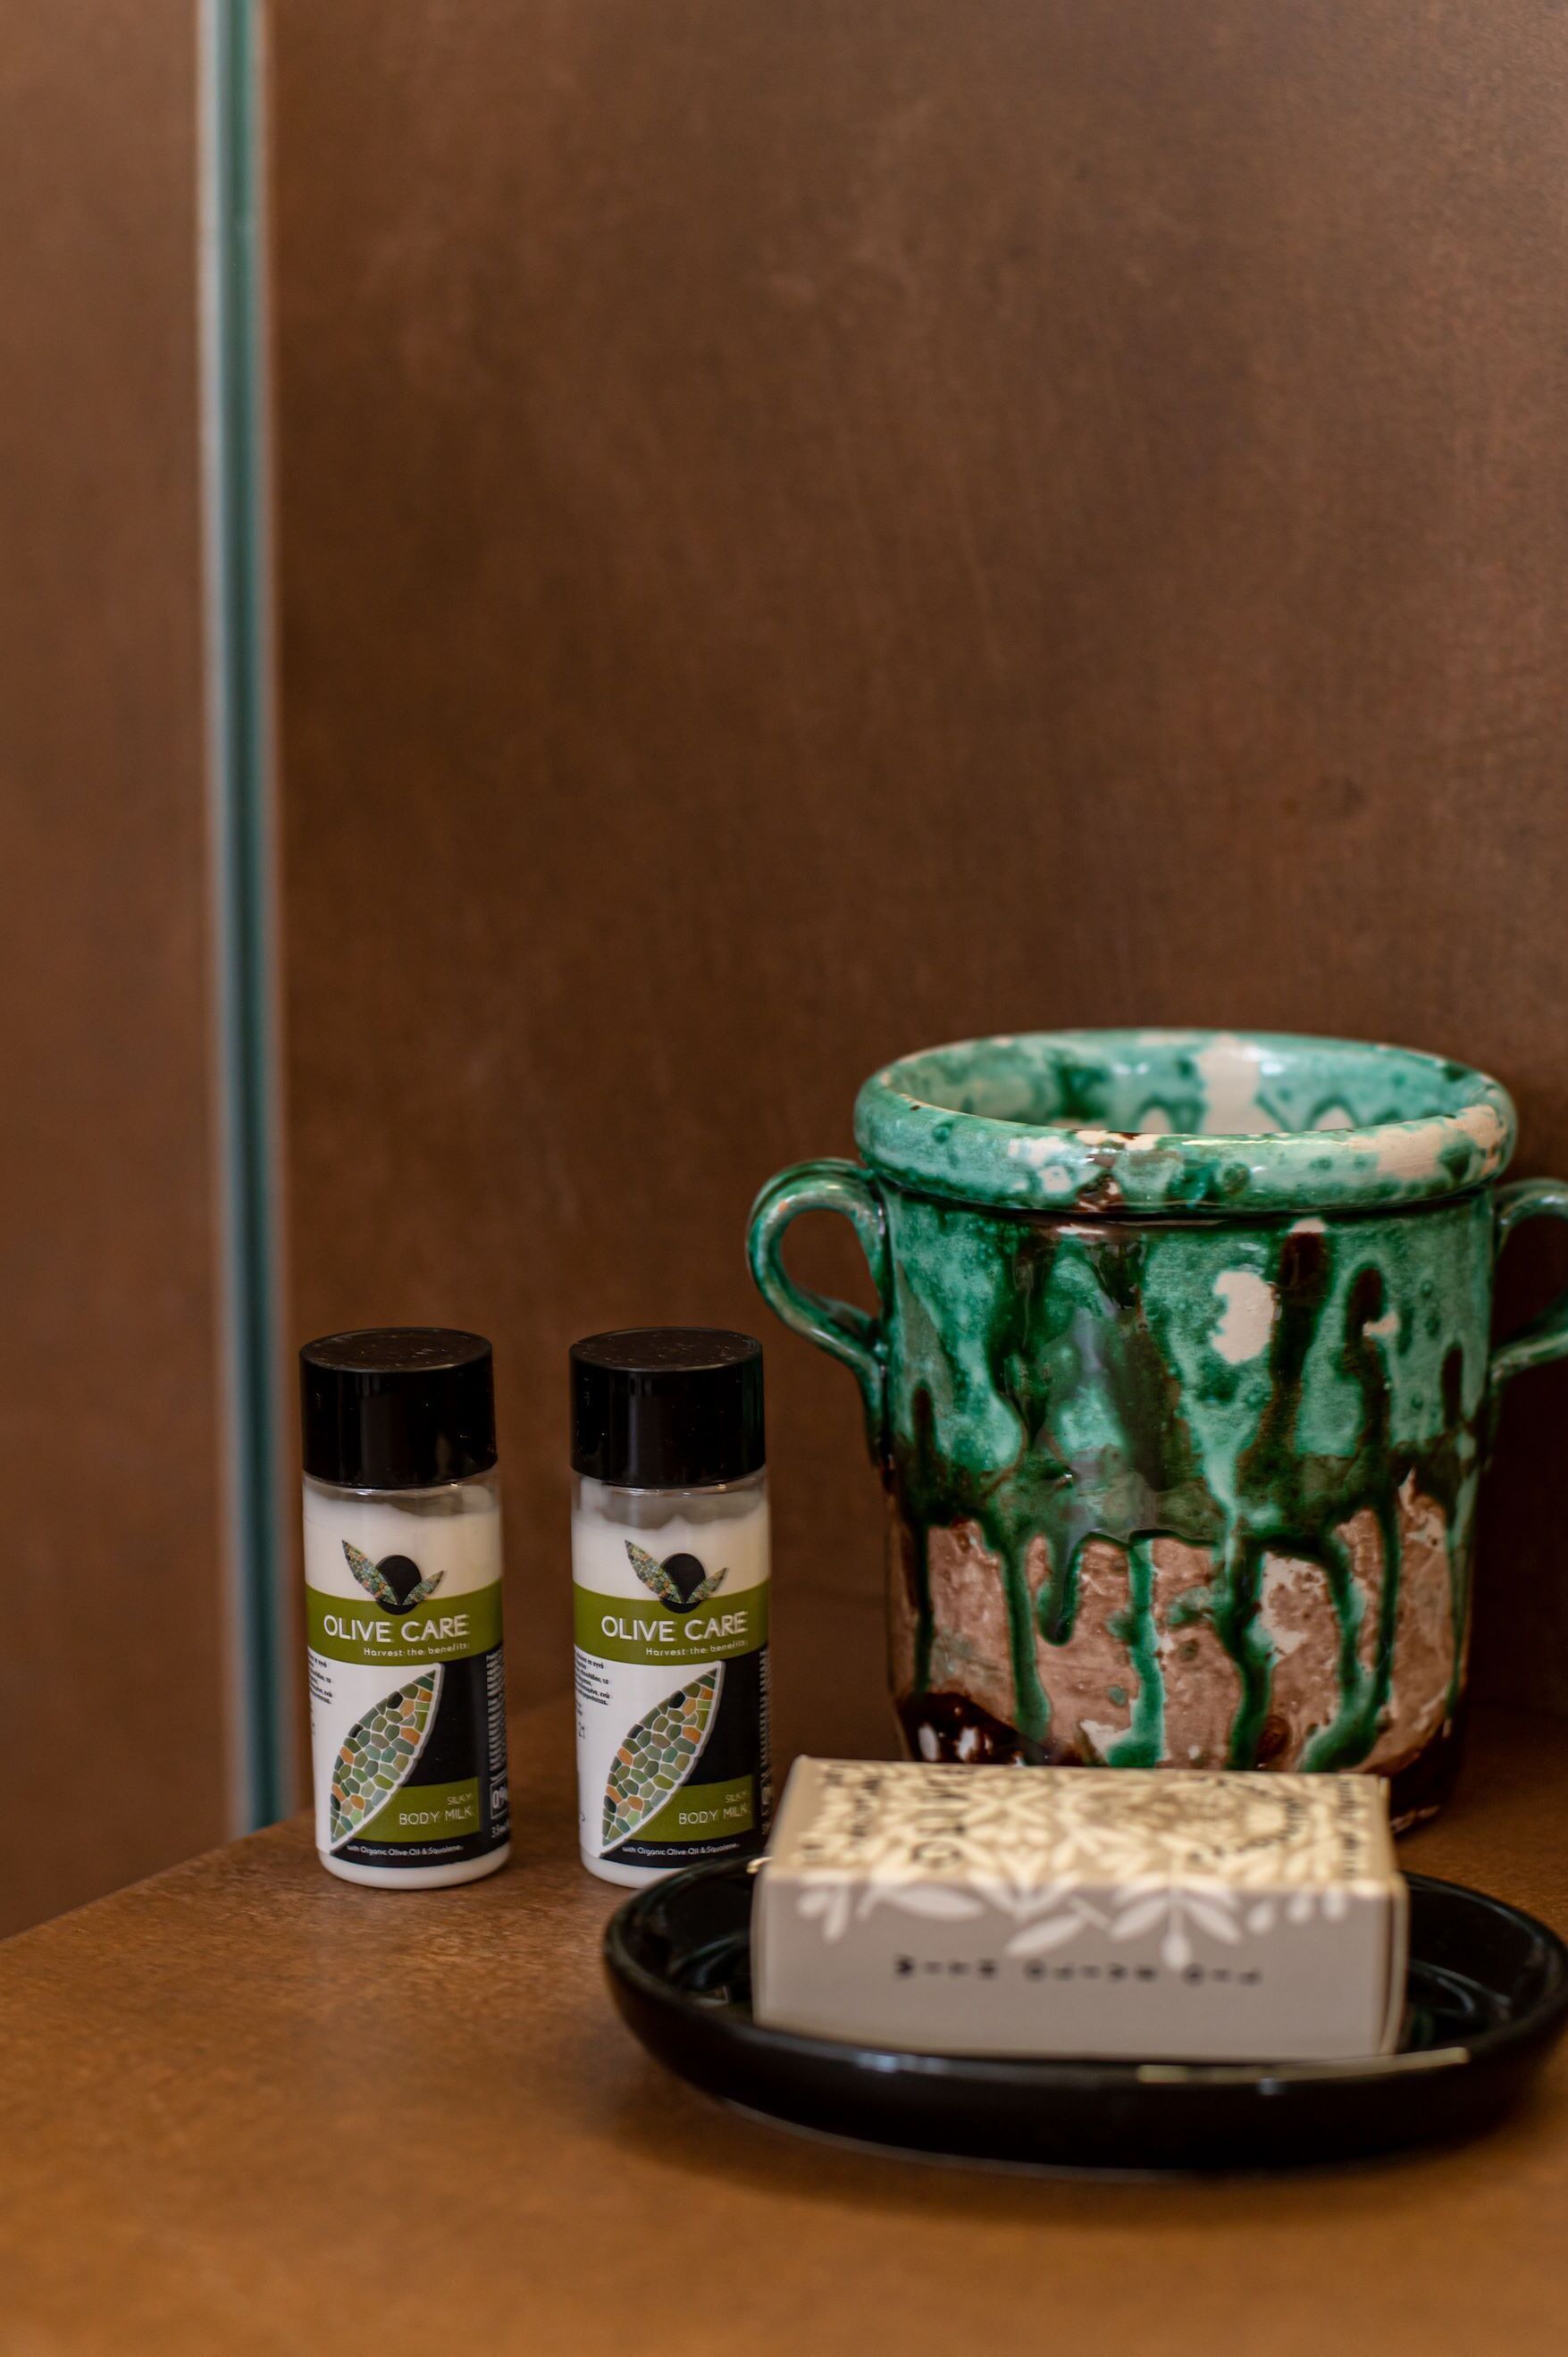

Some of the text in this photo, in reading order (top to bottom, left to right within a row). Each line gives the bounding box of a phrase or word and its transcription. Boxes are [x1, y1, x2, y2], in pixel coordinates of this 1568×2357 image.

[323, 1614, 469, 1642] OLIVE CARE
[601, 1611, 748, 1642] OLIVE CARE
[364, 1648, 402, 1657] Harvest
[407, 1648, 424, 1656] the
[646, 1648, 685, 1656] Harvest
[690, 1647, 706, 1655] the
[447, 1793, 472, 1806] SILKY
[725, 1791, 747, 1803] SILKY
[399, 1806, 473, 1825] BODY MILK
[679, 1805, 749, 1824] BODY MILK
[361, 1846, 387, 1856] Organic
[637, 1846, 666, 1857] Organic
[667, 1848, 686, 1856] Olive
